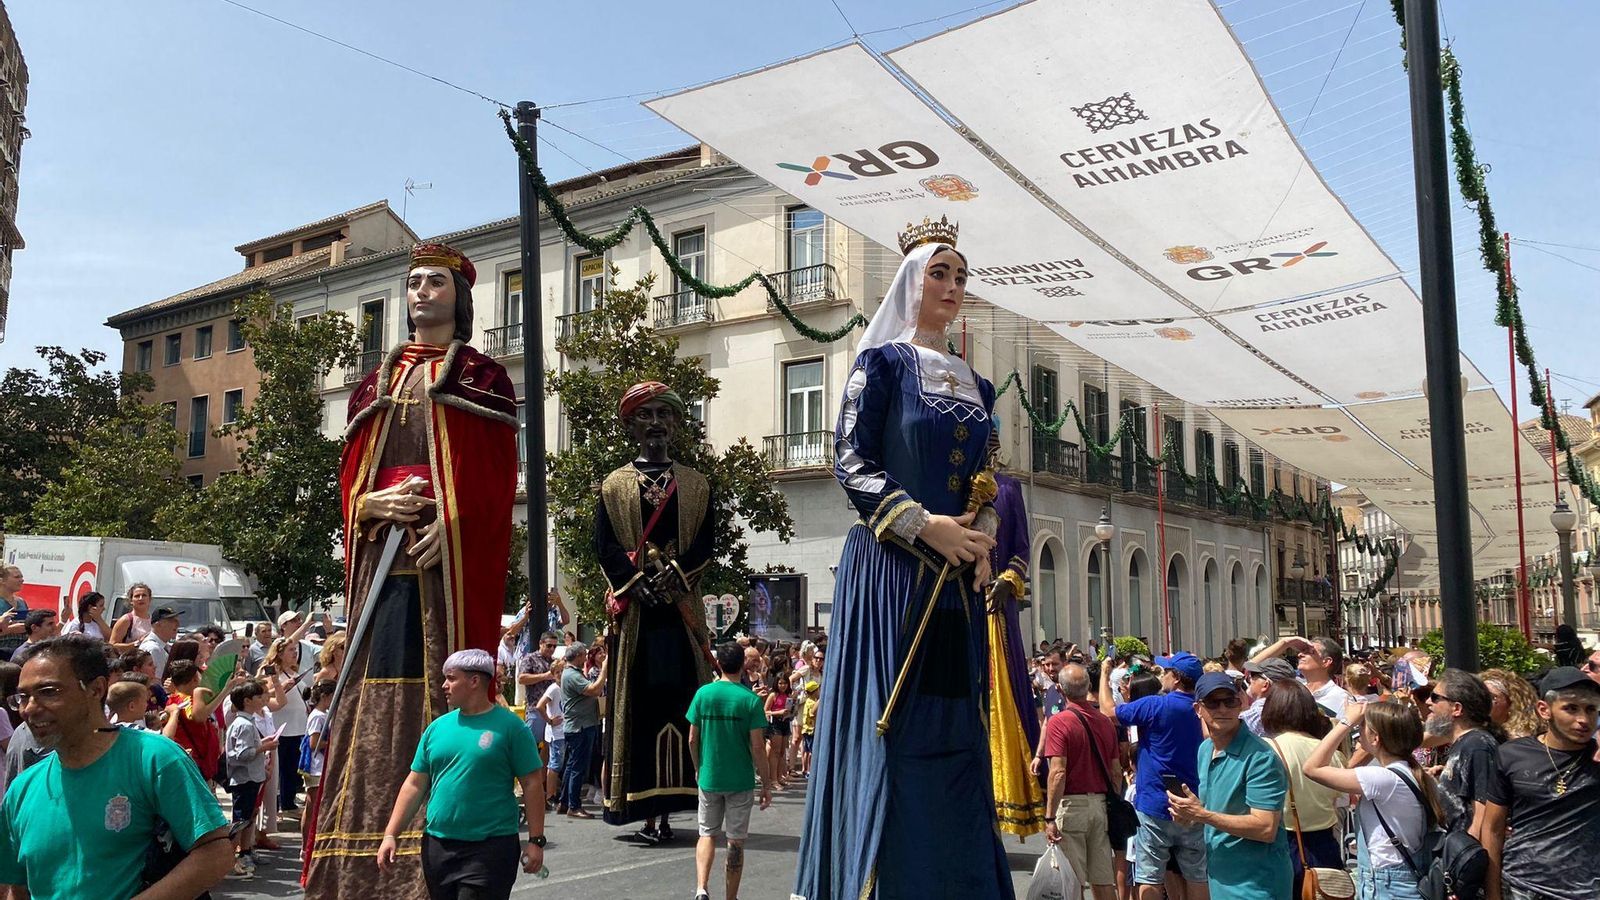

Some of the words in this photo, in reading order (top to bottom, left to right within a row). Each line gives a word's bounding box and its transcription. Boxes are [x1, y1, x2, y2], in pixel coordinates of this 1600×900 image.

[1059, 118, 1222, 169] CERVEZAS
[1072, 139, 1249, 189] ALHAMBRA
[839, 192, 927, 208] AYUNTAMIENTO
[967, 258, 1085, 277] ALHAMBR
[980, 270, 1094, 287] CERVEZAS
[1254, 292, 1371, 323] CERVEZAS
[1260, 302, 1388, 333] ALHAMBRA
